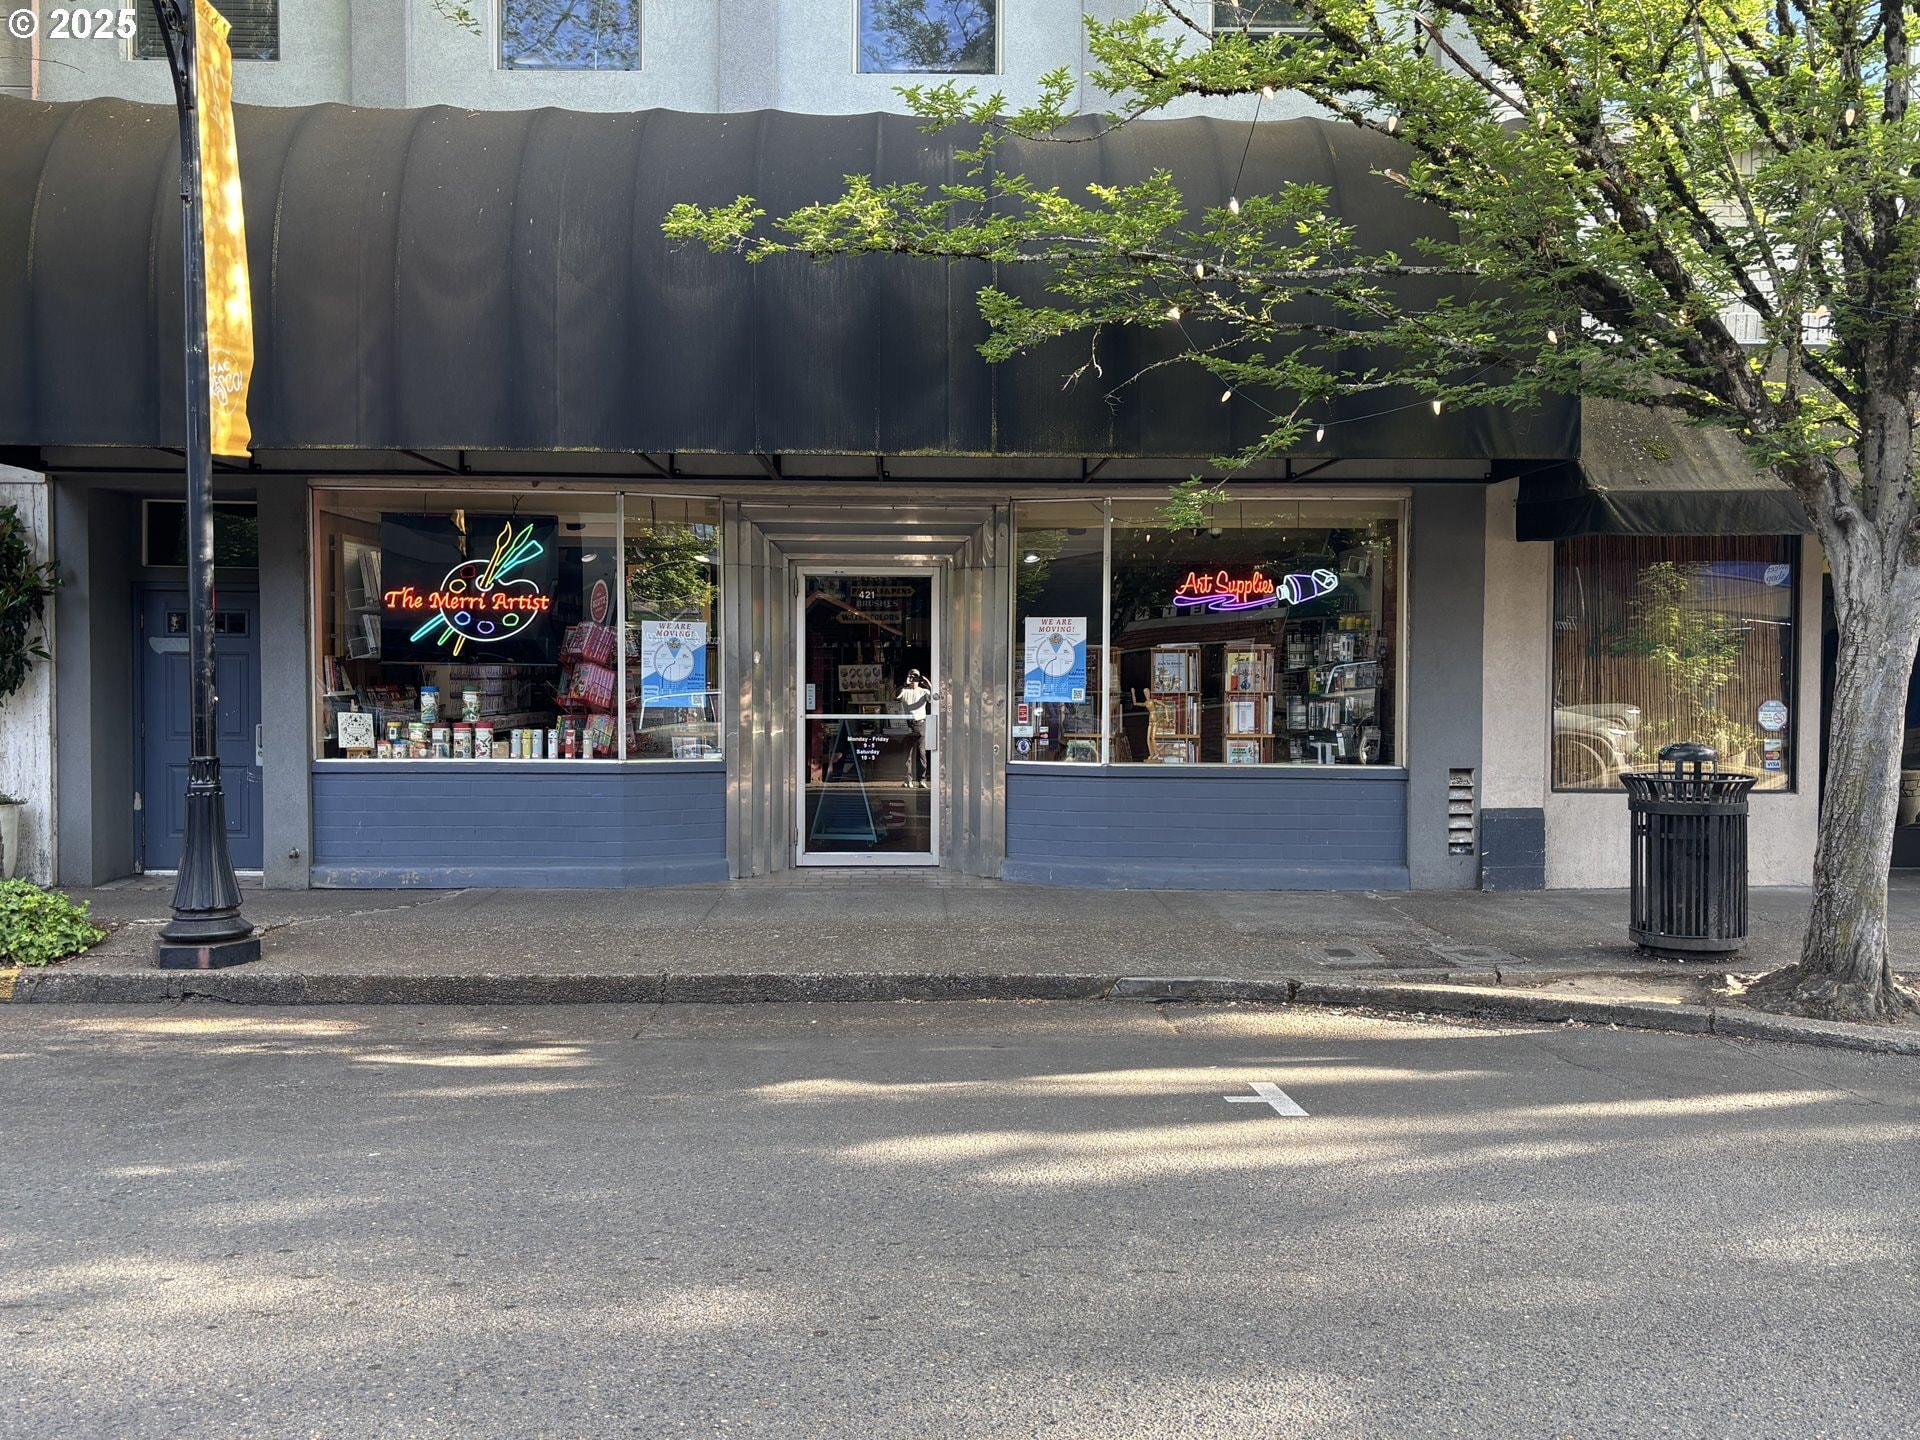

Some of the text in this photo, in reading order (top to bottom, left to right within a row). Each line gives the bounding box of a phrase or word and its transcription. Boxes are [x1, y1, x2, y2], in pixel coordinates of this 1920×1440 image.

[1175, 570, 1274, 603] Art Supplies
[384, 587, 550, 610] The Merri Artist
[858, 591, 875, 599] 421
[856, 600, 898, 608] BRUSHES
[870, 613, 900, 621] COLORS
